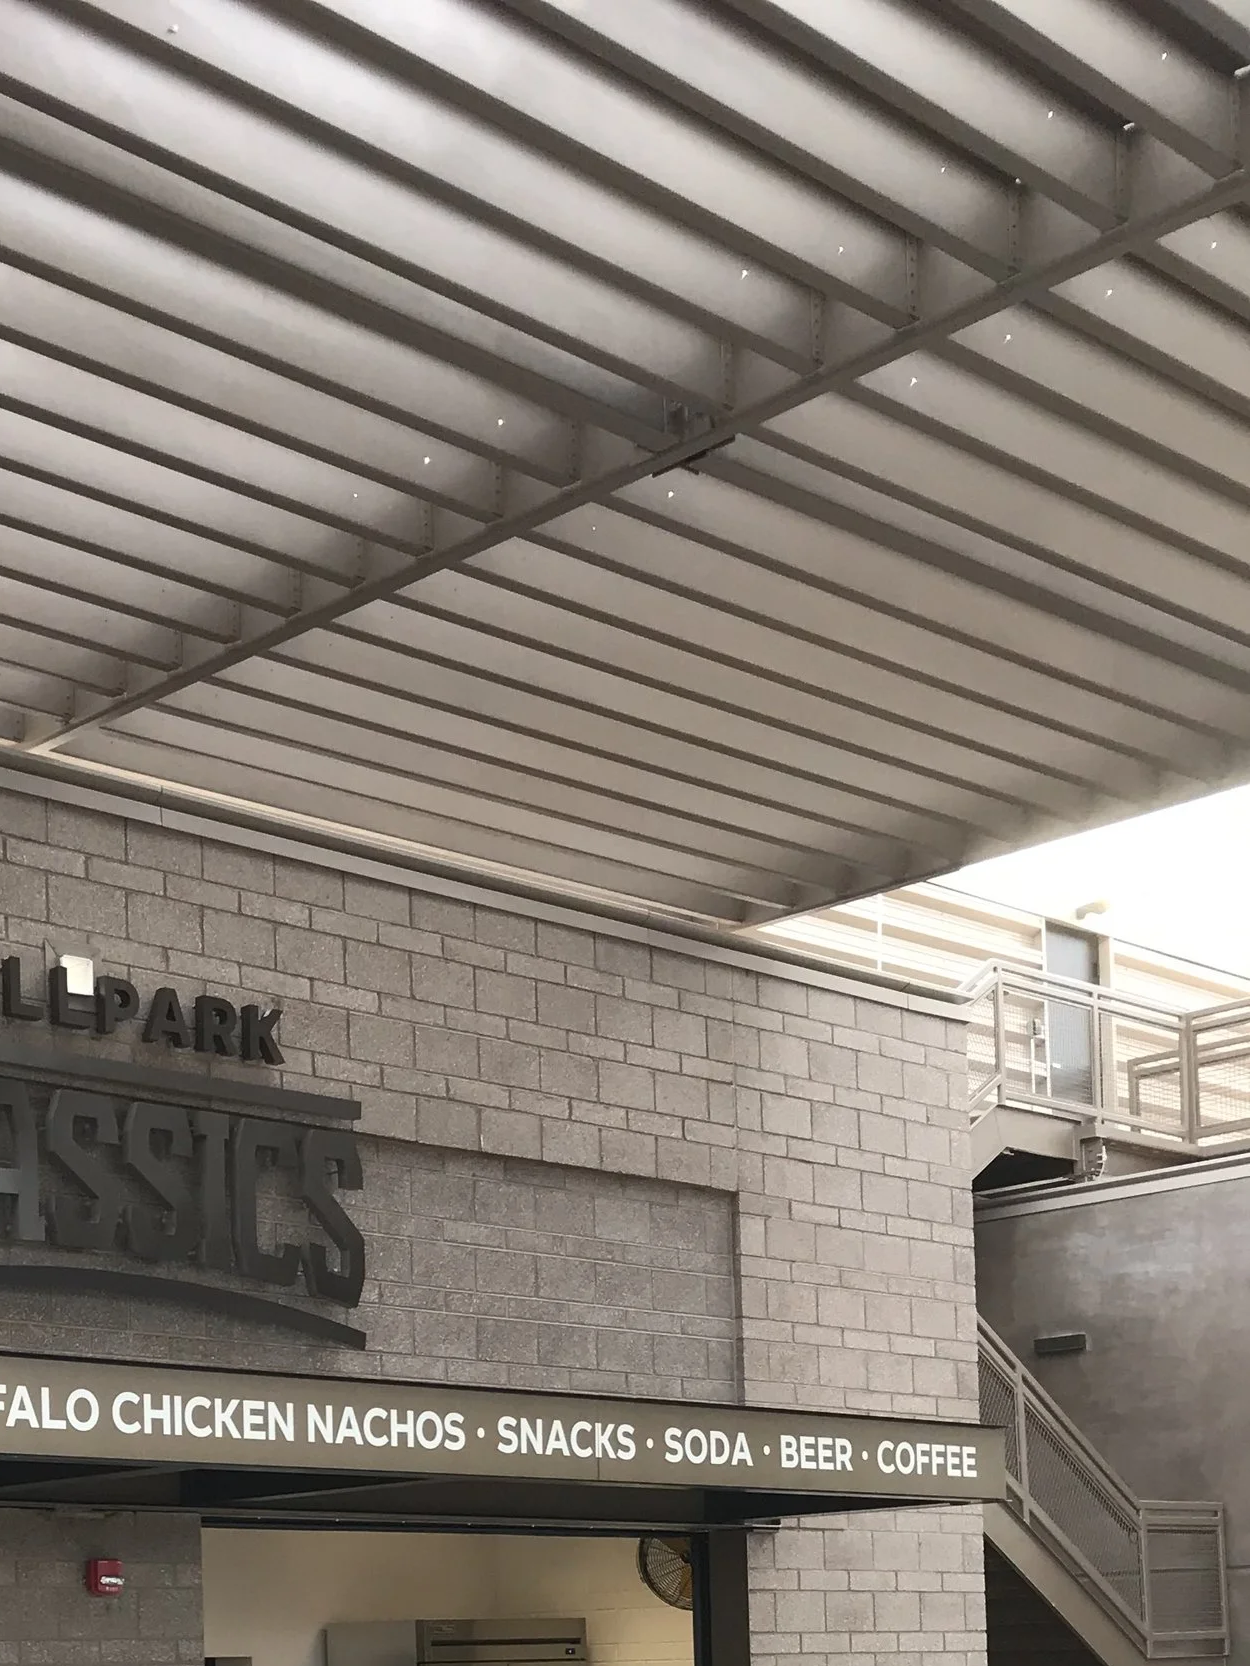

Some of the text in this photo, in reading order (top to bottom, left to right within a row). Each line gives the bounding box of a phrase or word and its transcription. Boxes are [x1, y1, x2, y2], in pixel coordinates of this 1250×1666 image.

[111, 1391, 295, 1442] CHICKEN
[307, 1404, 466, 1451] NACHOS
[497, 1416, 636, 1460] SNACKS
[664, 1427, 754, 1467] SODA
[780, 1434, 854, 1471] BEER
[877, 1440, 978, 1478] COFFEE
